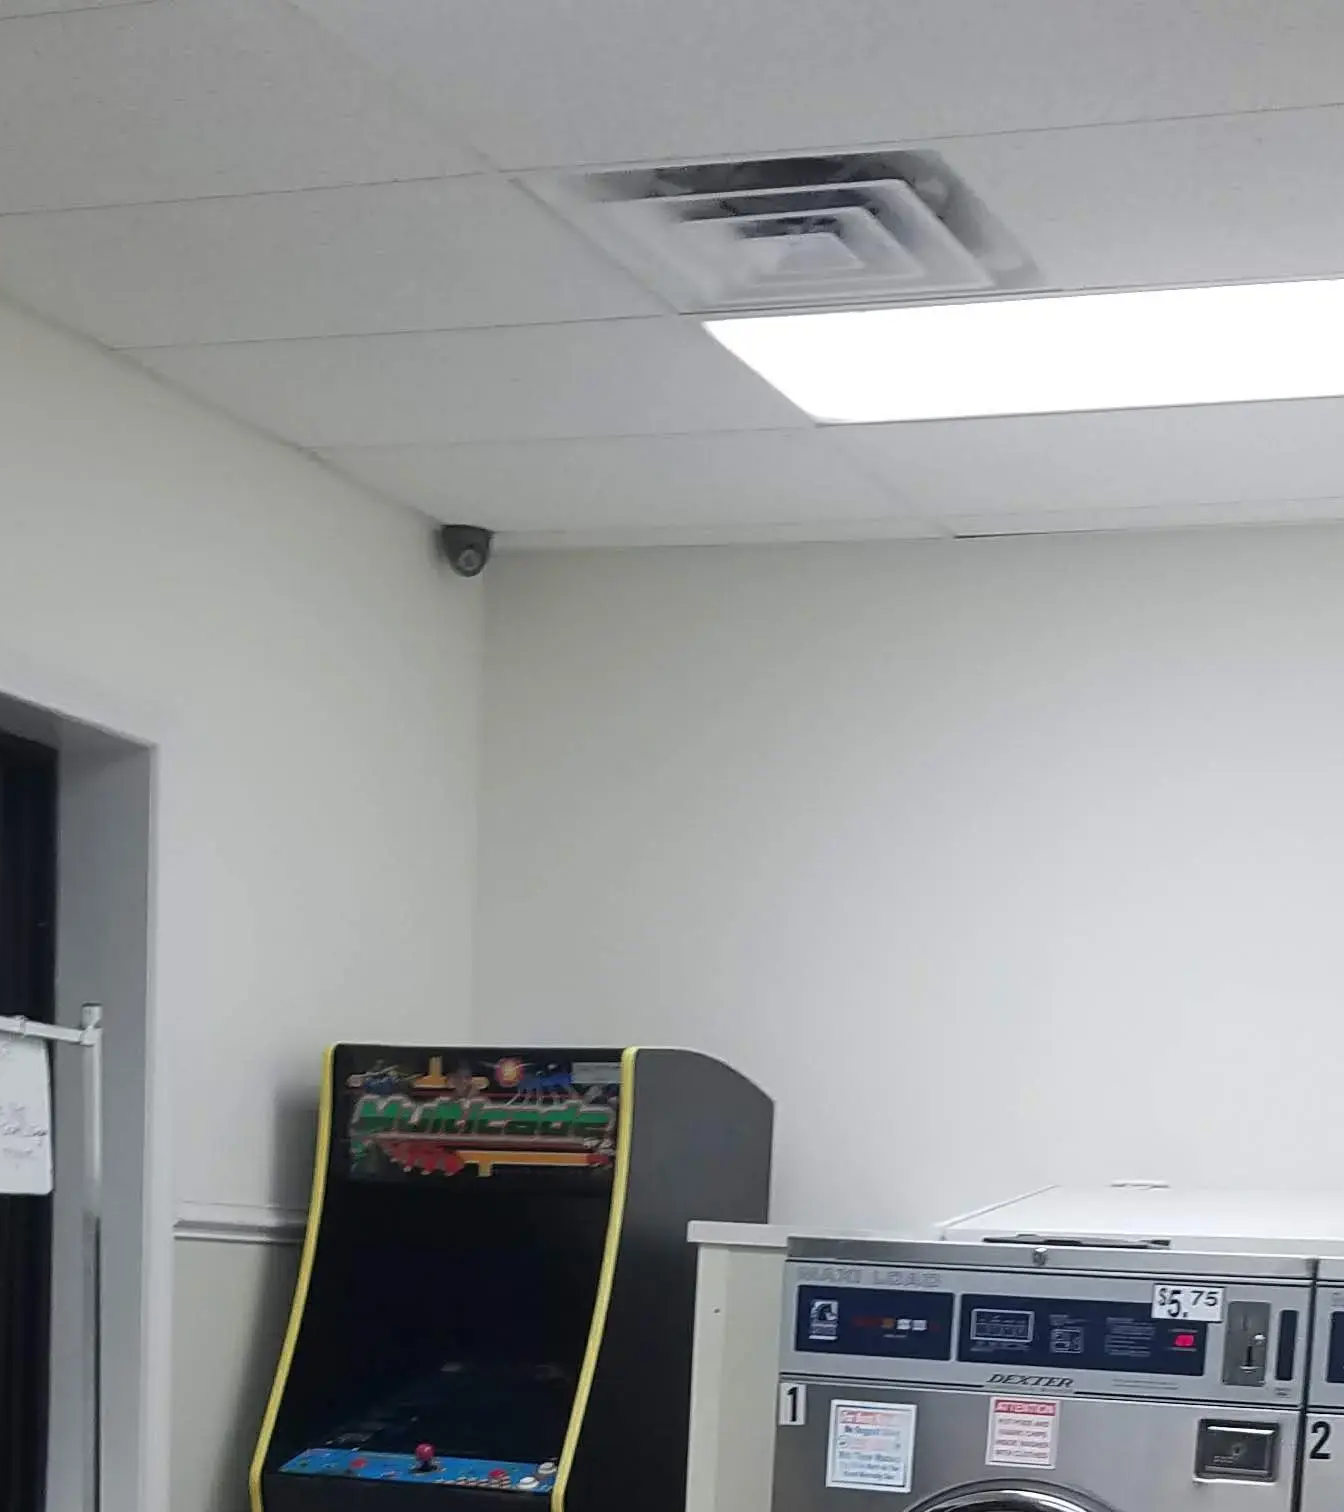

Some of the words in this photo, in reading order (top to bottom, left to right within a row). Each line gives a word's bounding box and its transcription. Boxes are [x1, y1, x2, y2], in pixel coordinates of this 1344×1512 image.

[986, 1373, 1074, 1388] DEXTER
[787, 1386, 799, 1422] 1
[1309, 1421, 1331, 1460] 2
